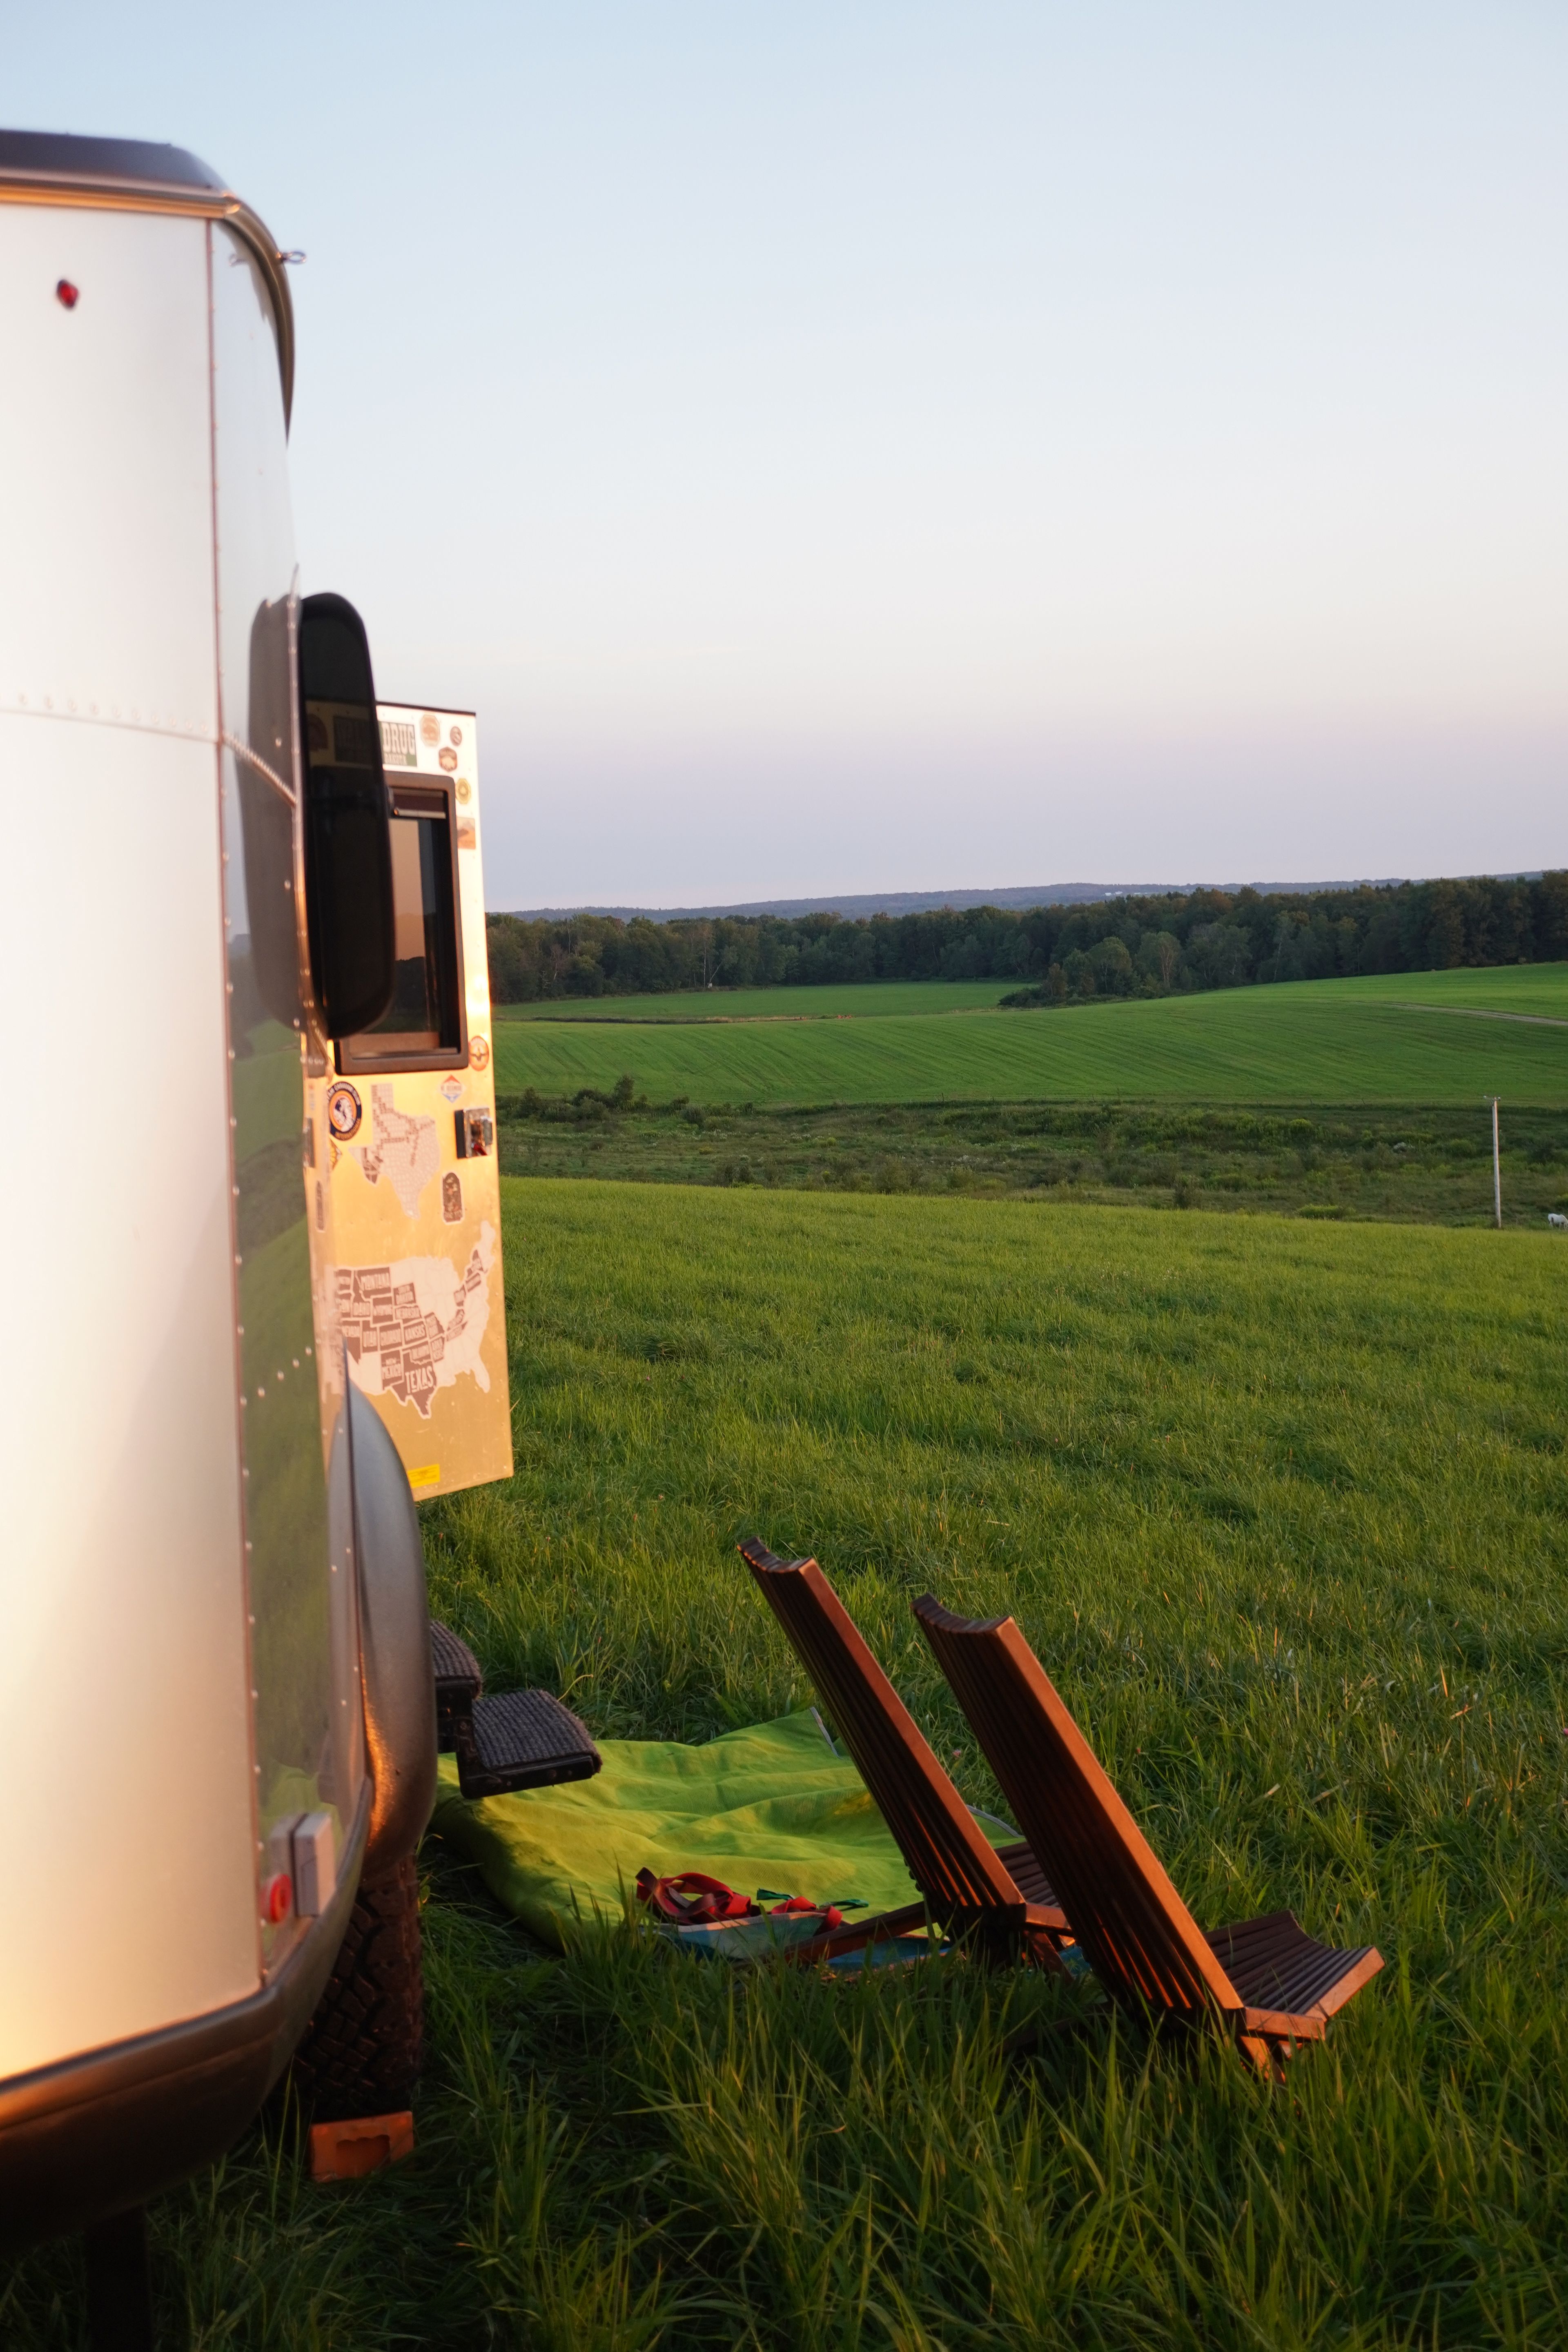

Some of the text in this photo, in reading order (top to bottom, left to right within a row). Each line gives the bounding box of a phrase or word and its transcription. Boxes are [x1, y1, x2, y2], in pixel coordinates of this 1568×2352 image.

[381, 722, 416, 756] DRUG
[360, 1272, 390, 1292] MONTANA
[363, 1330, 377, 1348] UTAH
[404, 1324, 427, 1342] KANSAS
[405, 1365, 434, 1394] TEXAS
